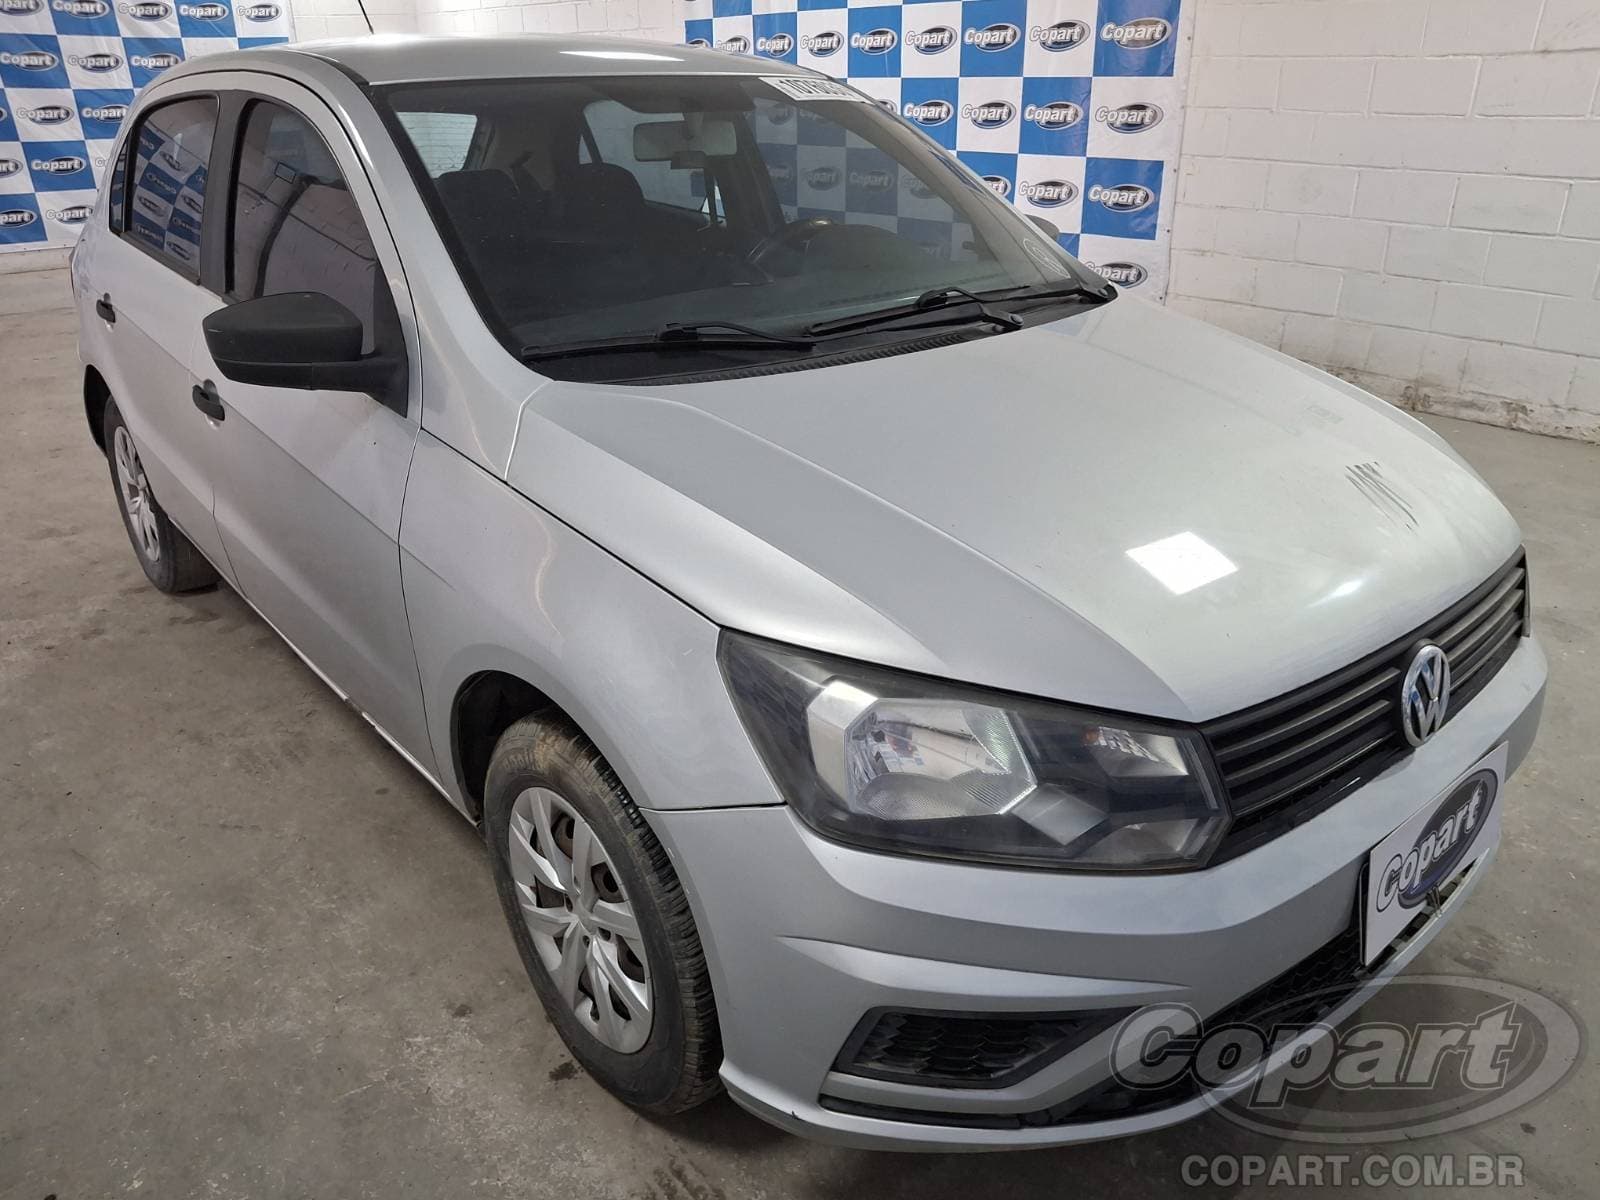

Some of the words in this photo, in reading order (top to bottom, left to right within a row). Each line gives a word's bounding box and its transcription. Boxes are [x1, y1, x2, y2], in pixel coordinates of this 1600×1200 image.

[0, 0, 36, 11] part
[52, 0, 103, 14] Copart
[119, 2, 165, 16] Copart
[180, 4, 224, 17] Copart
[238, 5, 277, 17] Copart
[850, 31, 893, 50] Copart
[905, 29, 950, 49] Copart
[964, 26, 1014, 47] Copart
[1030, 23, 1081, 43] Copart
[1101, 22, 1164, 44] Copart
[756, 36, 789, 53] Copart
[800, 34, 838, 52] Copart
[0, 52, 53, 68] Copart
[68, 55, 117, 69] Copart
[131, 55, 175, 68] Copart
[17, 106, 67, 121] Copart
[903, 102, 949, 122] Copart
[962, 104, 1010, 124] Copart
[1024, 104, 1075, 124] Copart
[1095, 105, 1154, 125] Copart
[32, 159, 80, 172] Copart
[1019, 180, 1068, 200] Copart
[1088, 184, 1147, 205] Copart
[0, 211, 30, 225] part
[46, 207, 91, 221] Copart
[1376, 779, 1488, 912] Copart
